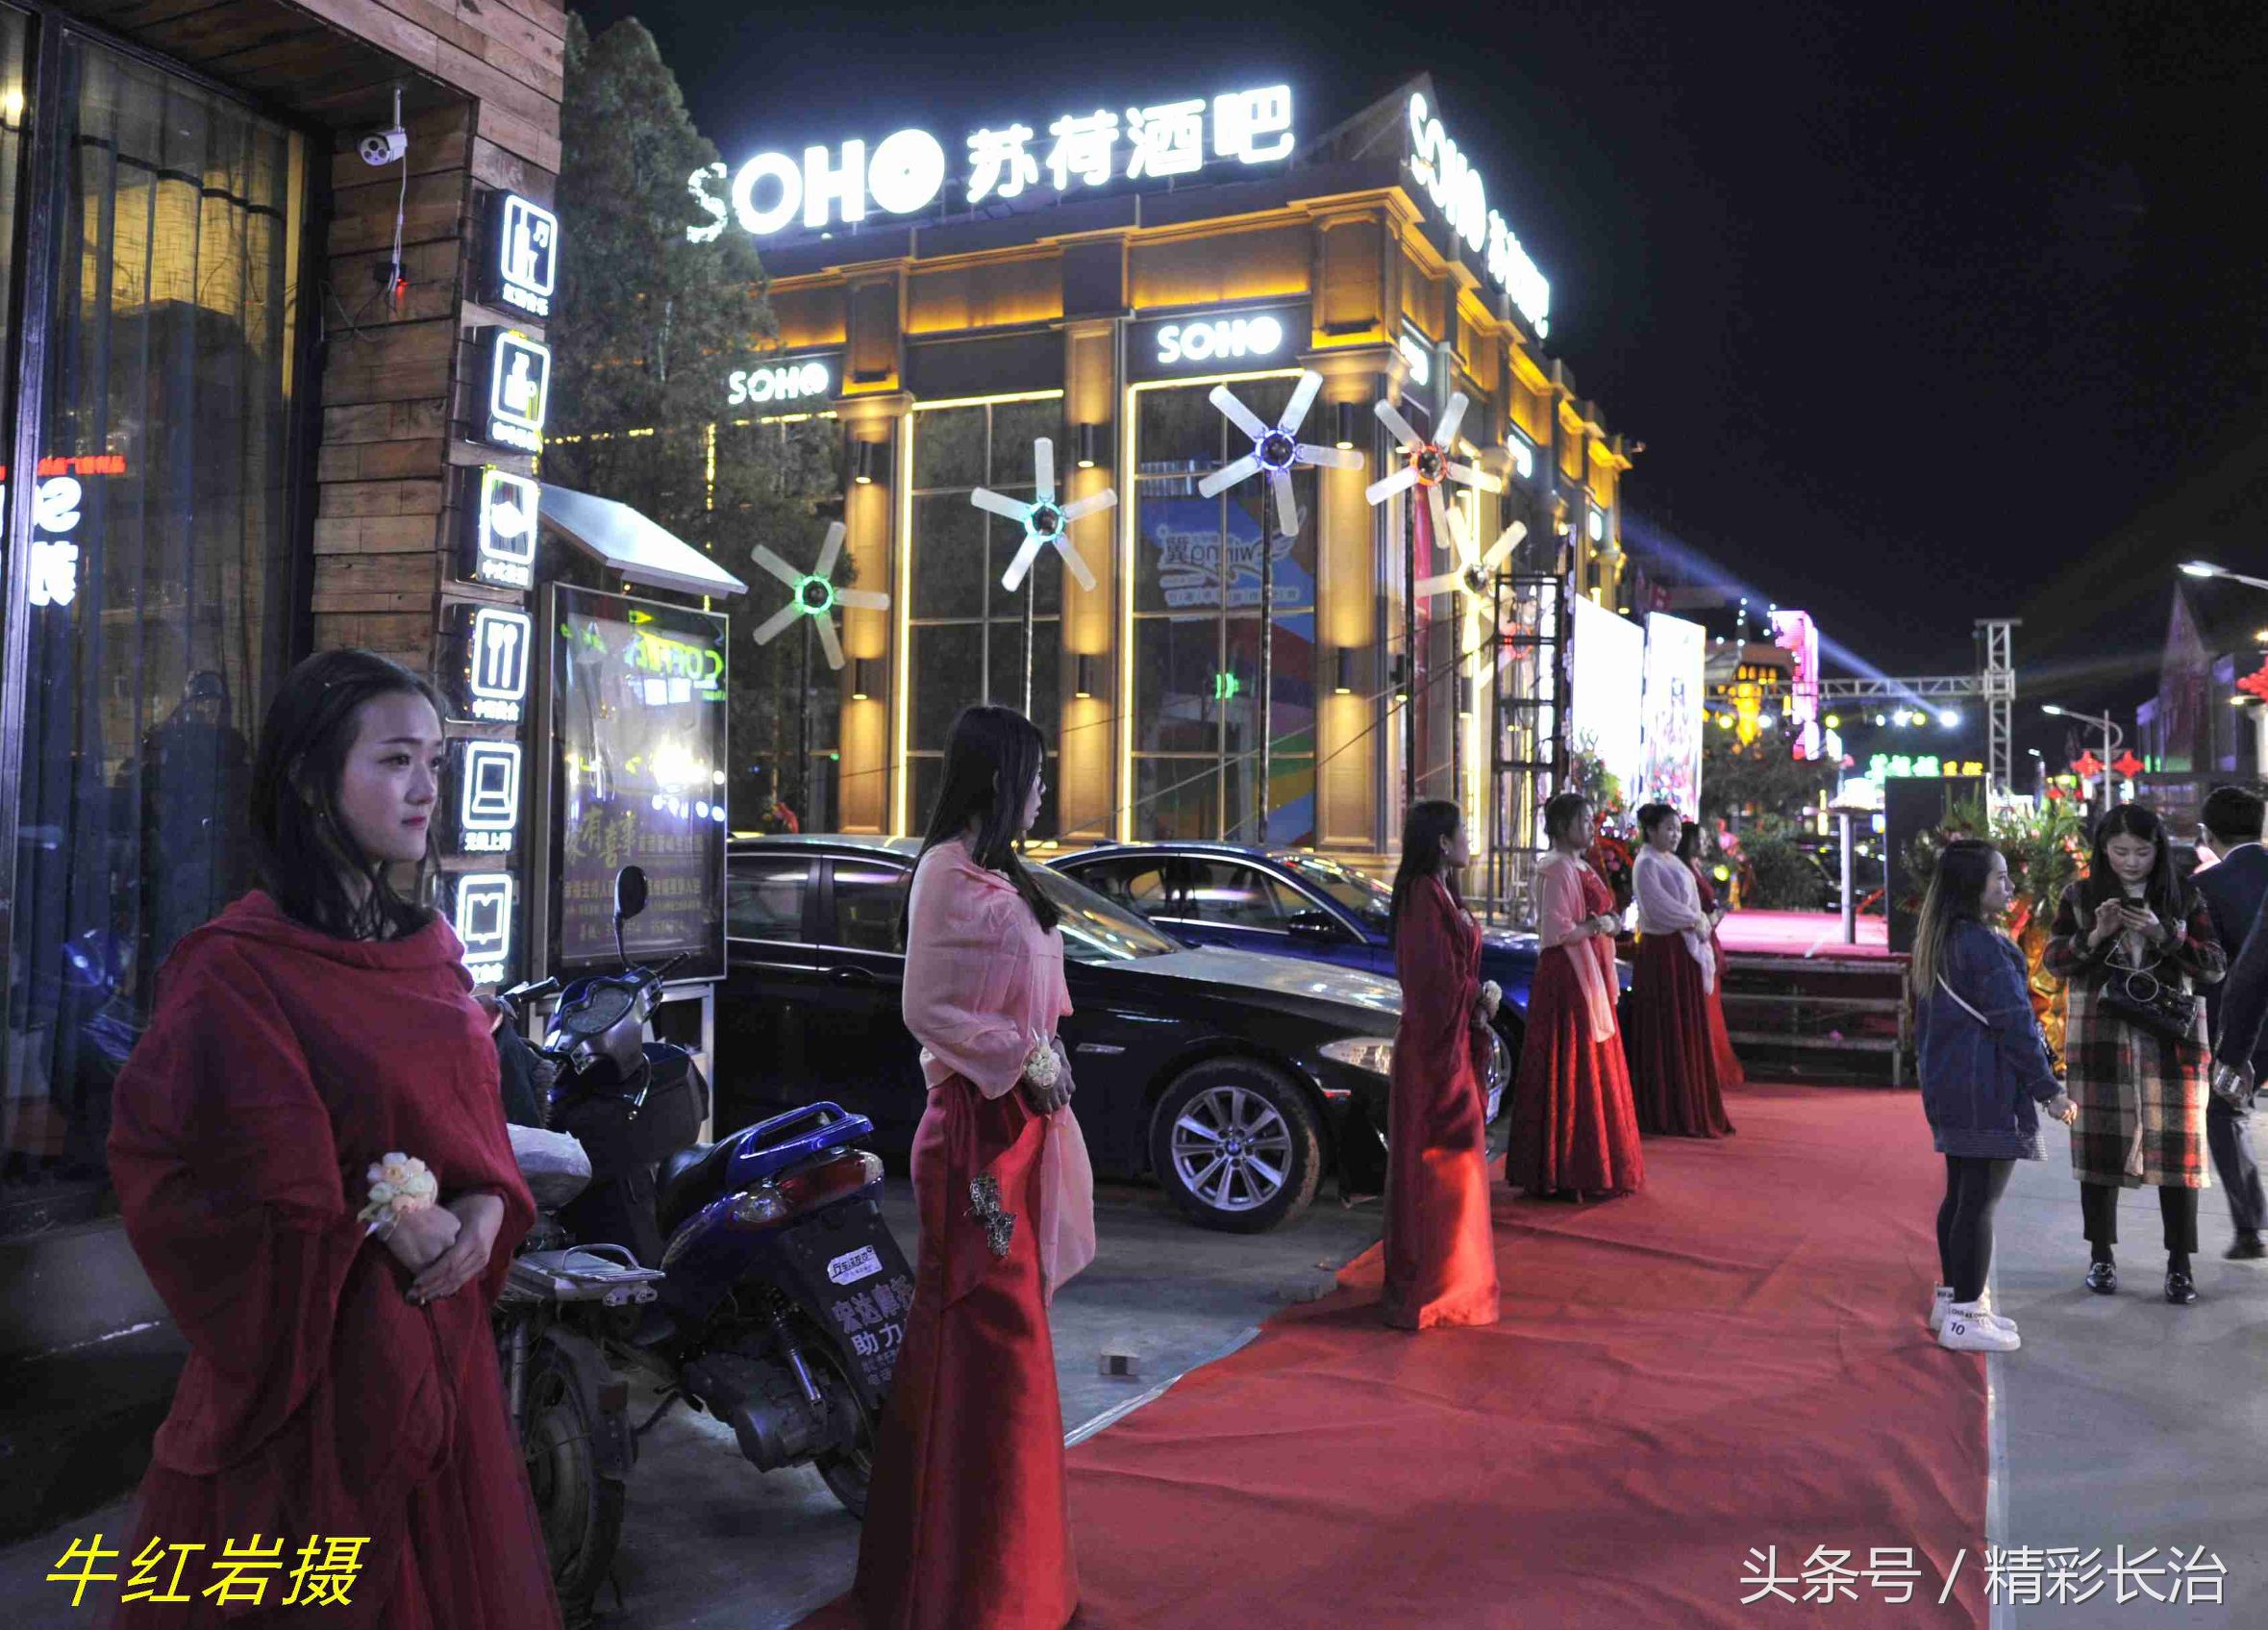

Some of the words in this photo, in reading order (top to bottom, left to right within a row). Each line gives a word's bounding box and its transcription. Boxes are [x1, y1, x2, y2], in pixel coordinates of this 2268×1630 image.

[685, 129, 945, 243] SOHO
[966, 85, 1295, 204] 苏荷酒吧
[1157, 315, 1283, 364] SOHO
[728, 362, 829, 405] SOHO
[1951, 1322, 1965, 1335] 10
